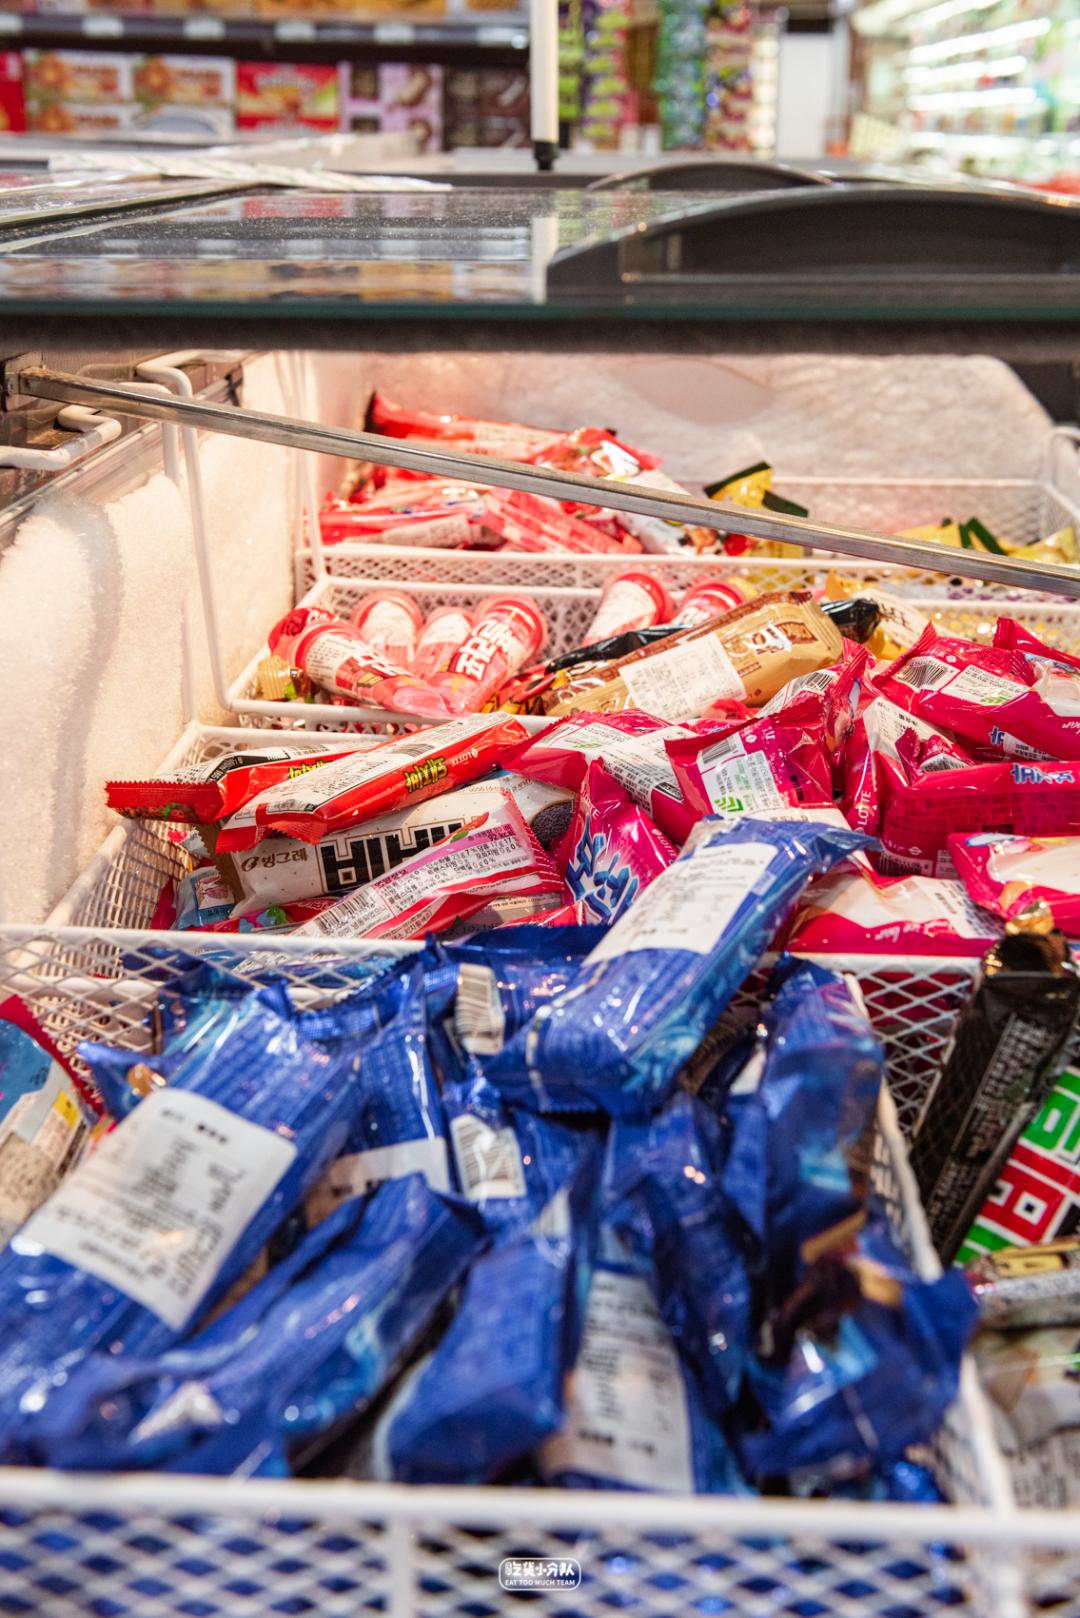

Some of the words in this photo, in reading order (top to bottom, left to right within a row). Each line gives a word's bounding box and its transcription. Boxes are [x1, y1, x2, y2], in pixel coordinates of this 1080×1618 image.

[450, 751, 472, 767] LOTTE
[405, 756, 448, 793] 돼지바
[857, 788, 872, 826] LOTTE
[262, 846, 309, 869] 빙그레
[656, 835, 677, 858] LOTTE
